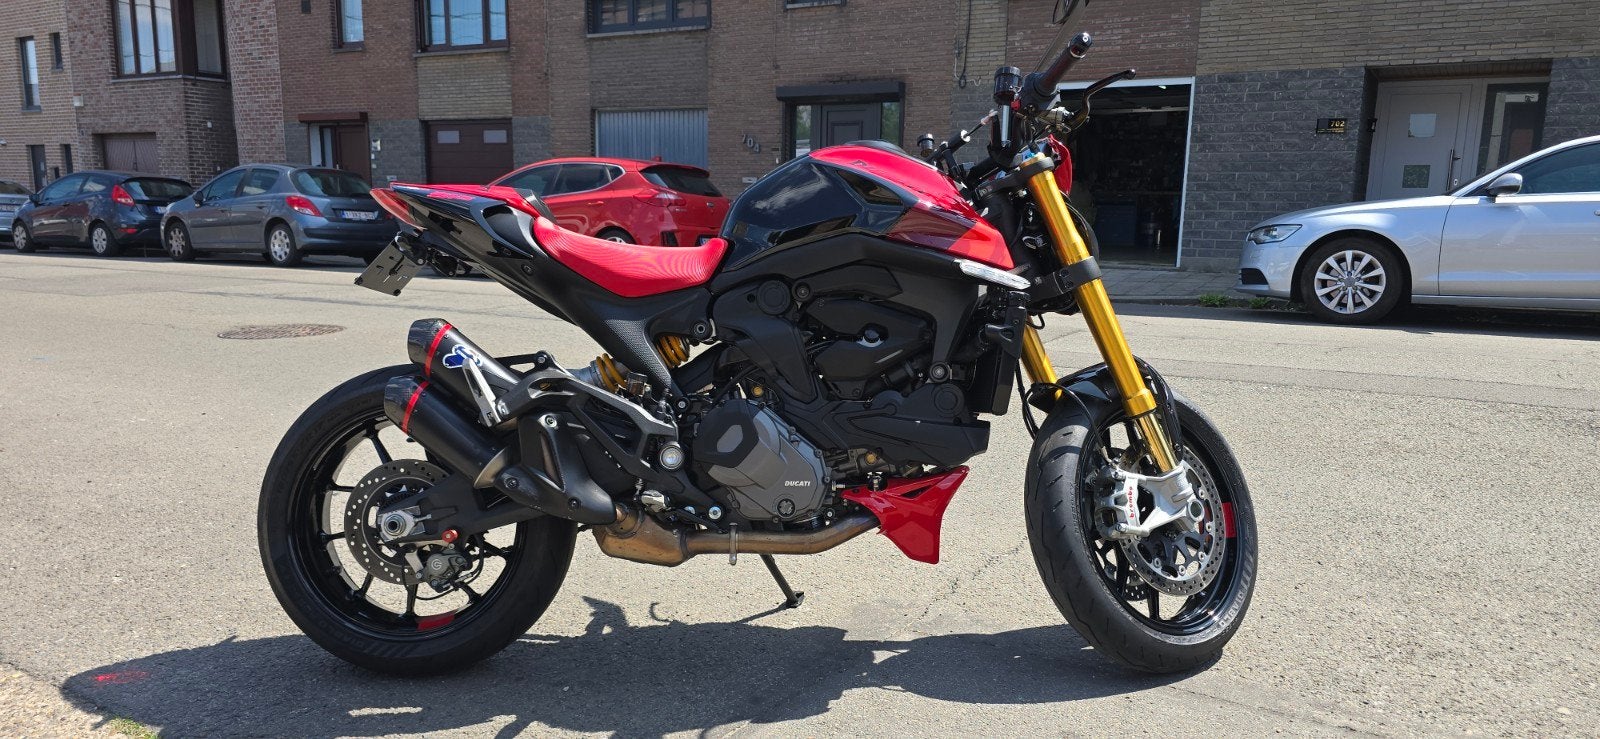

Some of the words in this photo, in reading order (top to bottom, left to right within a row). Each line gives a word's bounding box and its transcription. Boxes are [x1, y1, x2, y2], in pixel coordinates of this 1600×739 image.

[742, 134, 760, 153] 704
[1127, 486, 1135, 518] brembo
[1218, 590, 1246, 628] DIABLO
